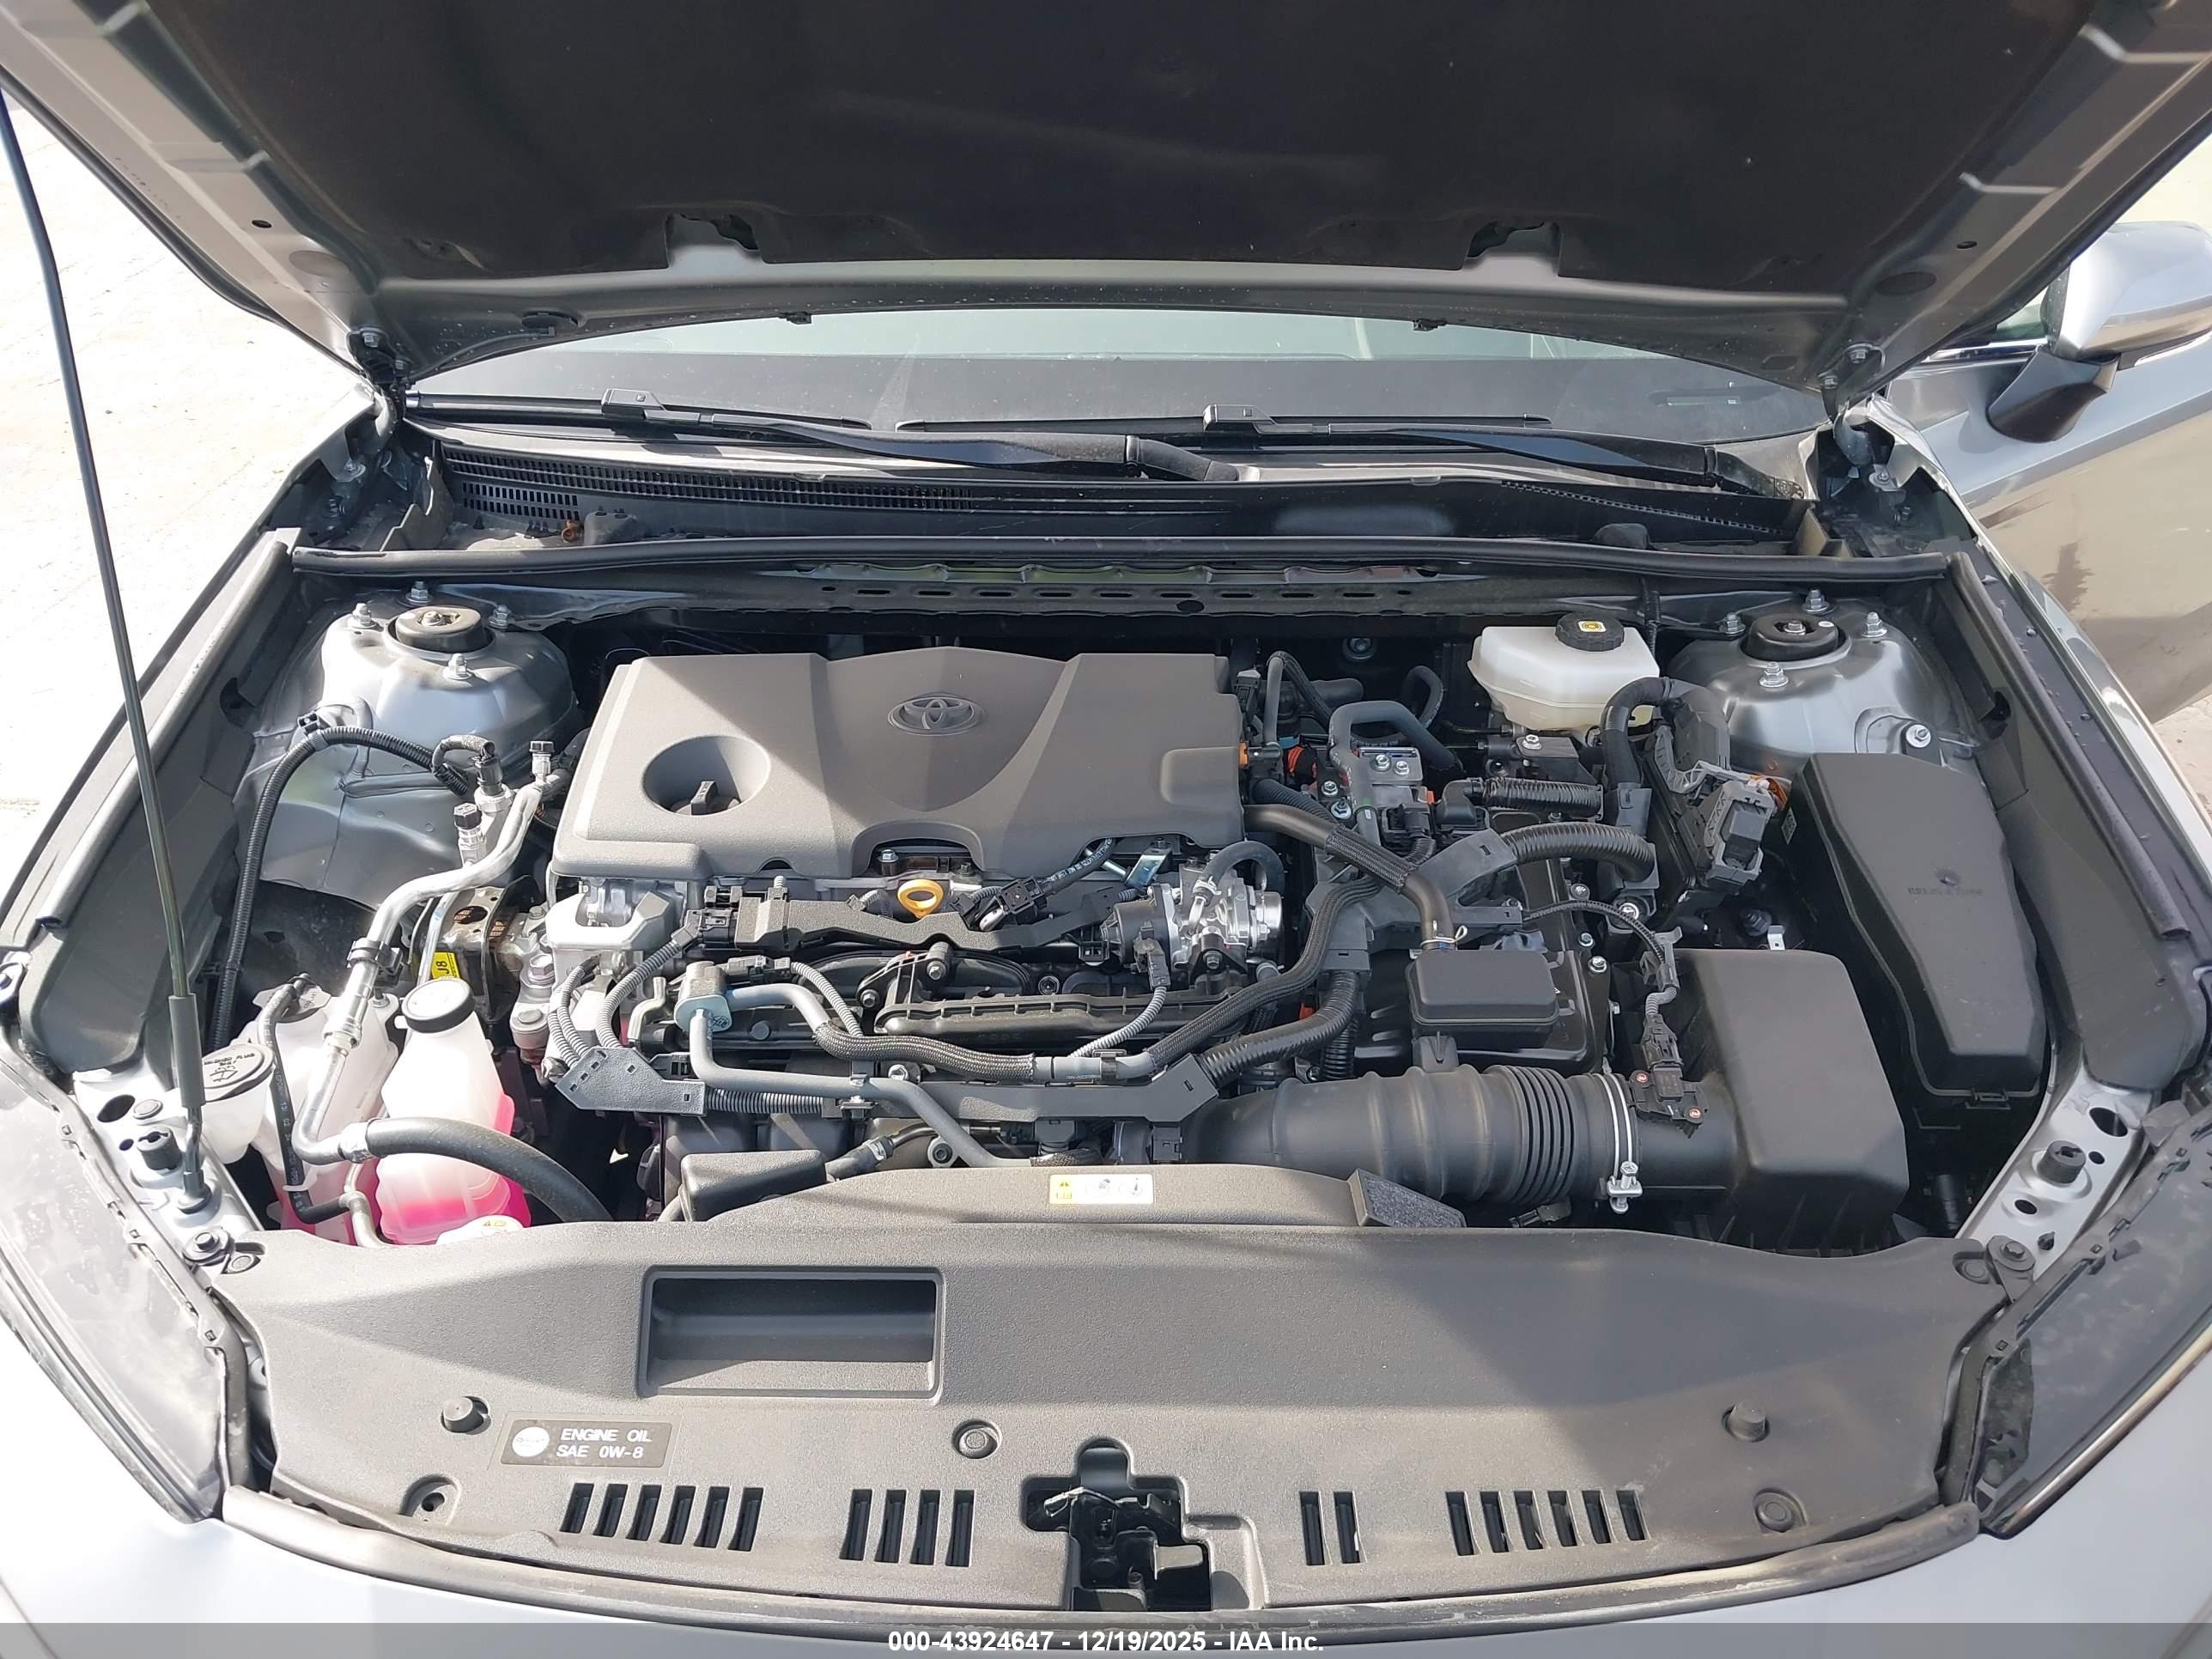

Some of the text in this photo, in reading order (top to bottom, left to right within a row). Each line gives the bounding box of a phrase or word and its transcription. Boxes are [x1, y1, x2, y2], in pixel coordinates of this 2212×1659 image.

[560, 1428, 619, 1442] ENGINE
[627, 1429, 653, 1443] OIL
[556, 1444, 644, 1459] SAE 0W-8
